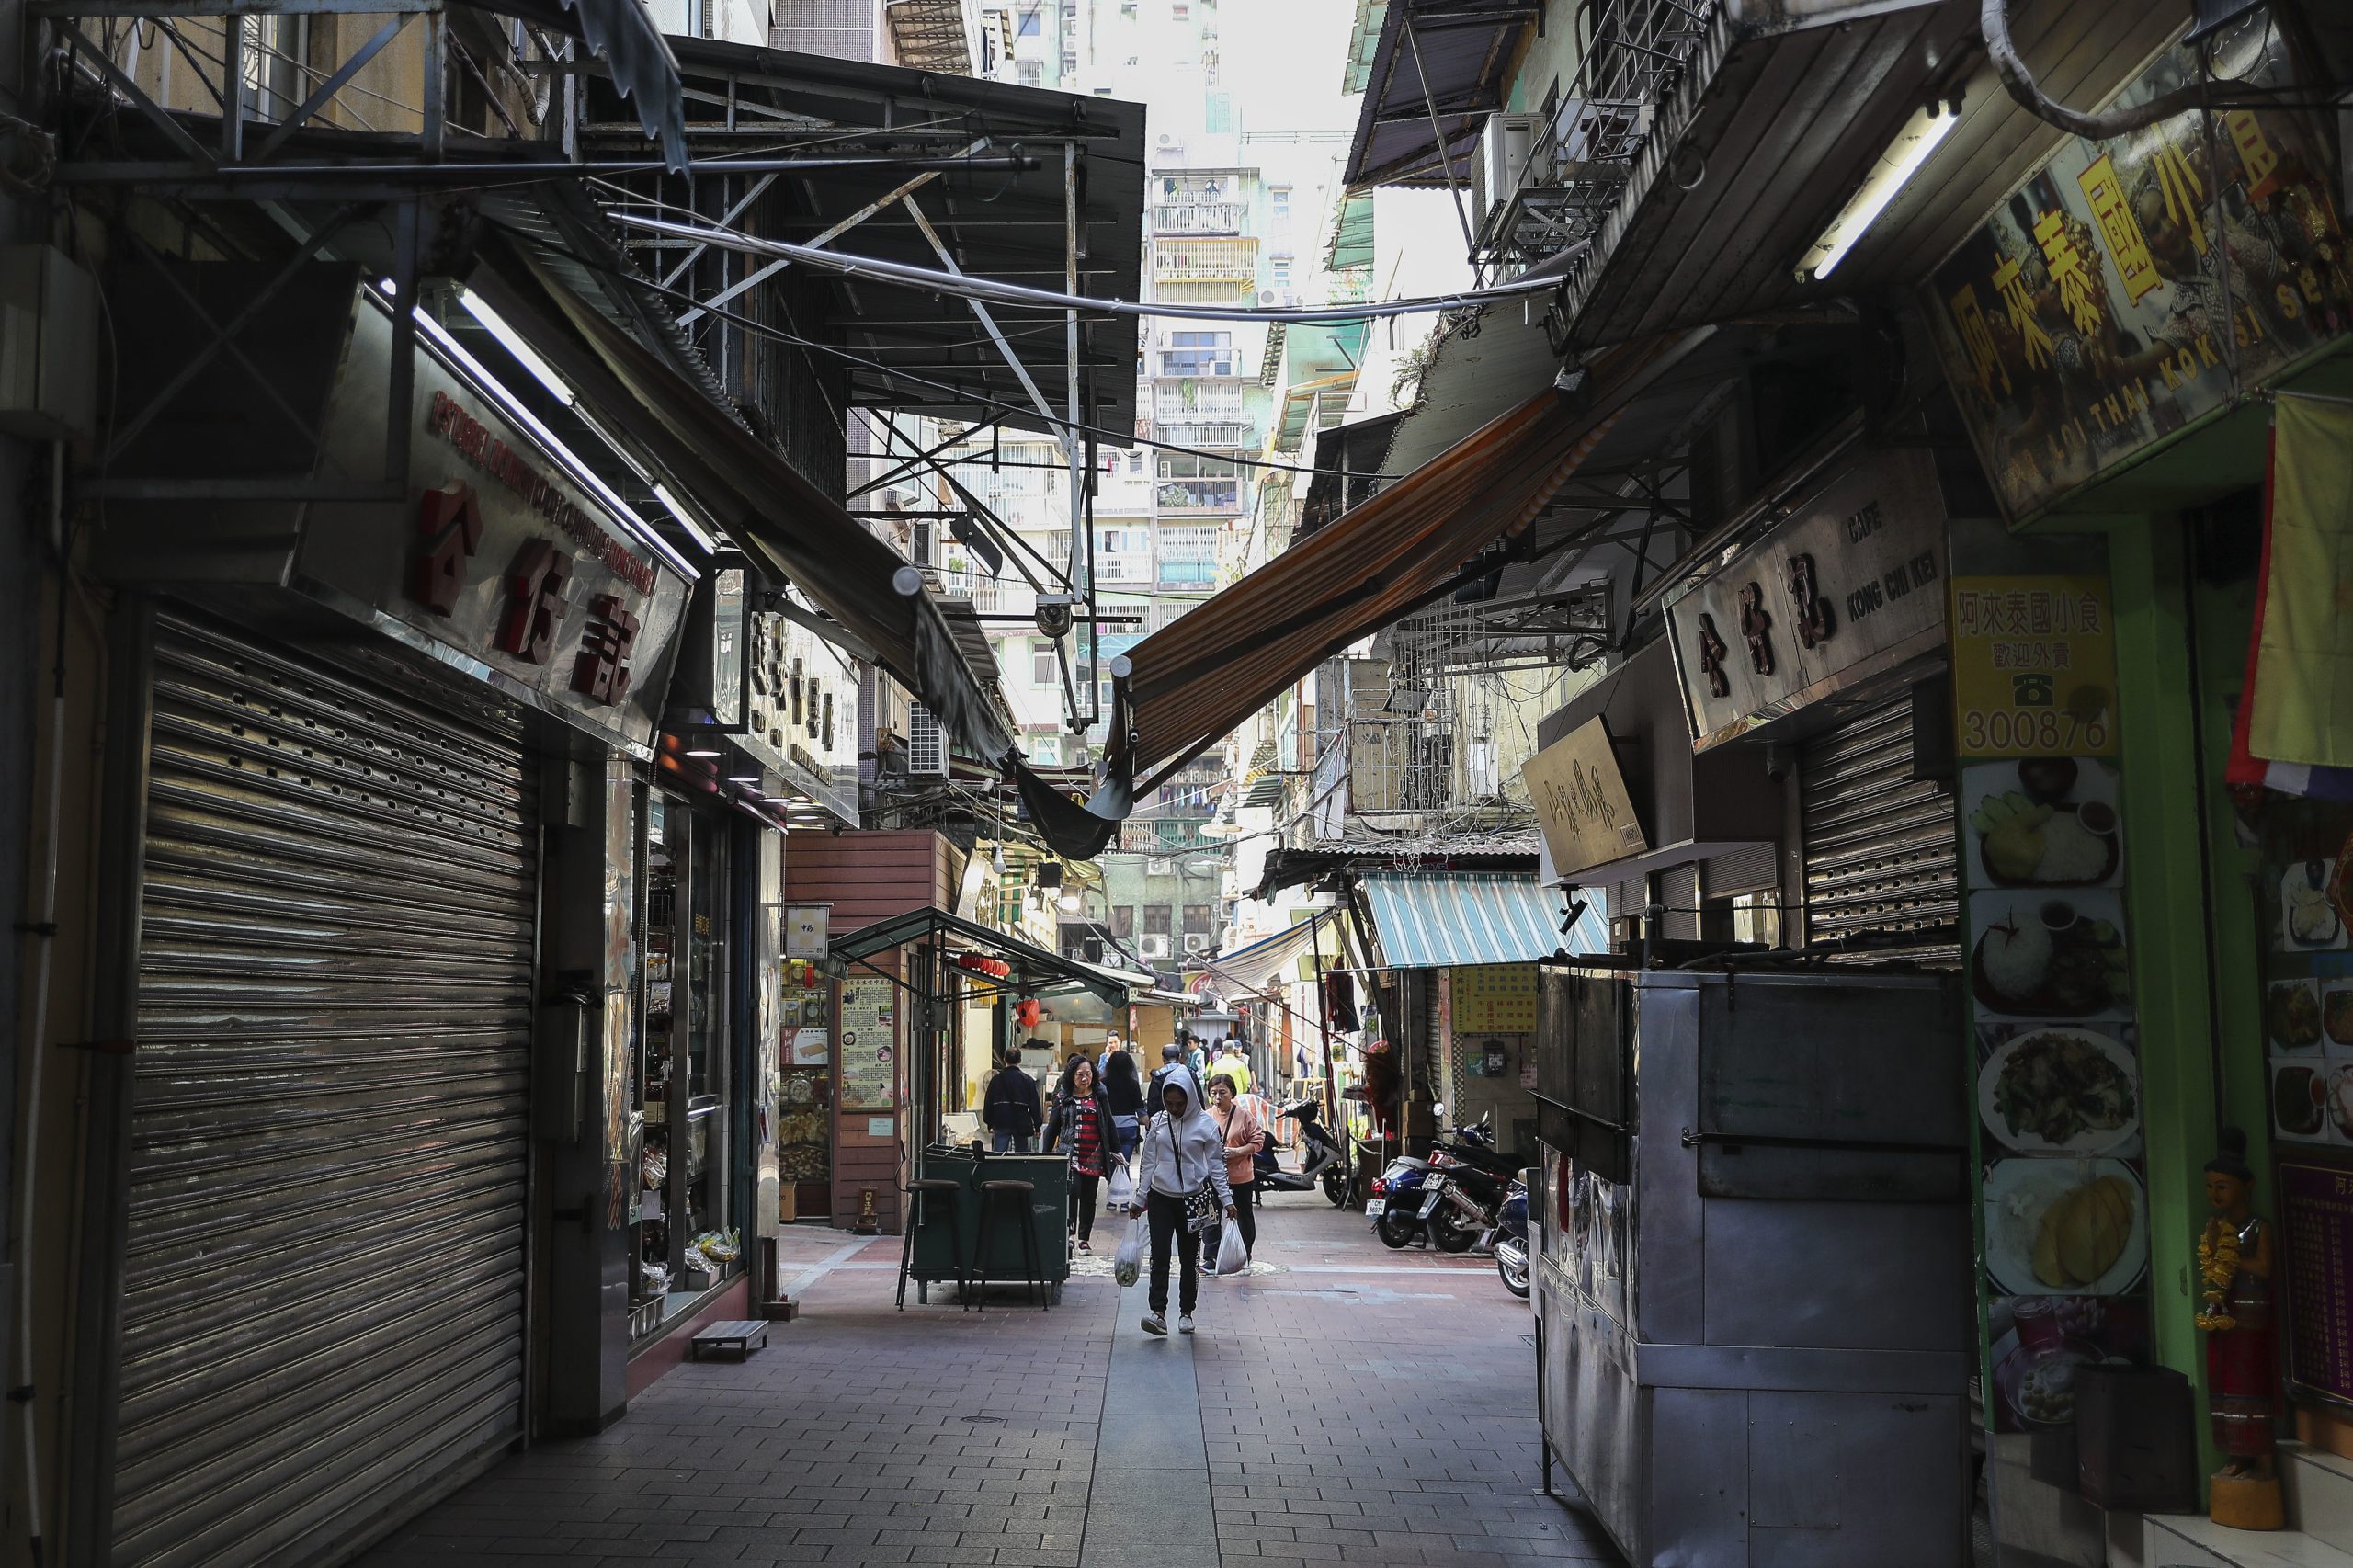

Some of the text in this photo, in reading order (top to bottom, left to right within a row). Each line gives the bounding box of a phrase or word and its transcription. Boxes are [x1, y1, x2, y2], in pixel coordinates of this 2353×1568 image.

[2088, 376, 2151, 433] THAI
[2158, 333, 2220, 392] KOK
[2234, 305, 2264, 348] SI
[1847, 500, 1883, 545] CAFE
[1846, 550, 1938, 622] KONG CHI KEI
[1958, 591, 2101, 636] 阿來泰國小食
[1992, 642, 2070, 669] 歡迎外賣
[1965, 710, 2107, 749] 300876
